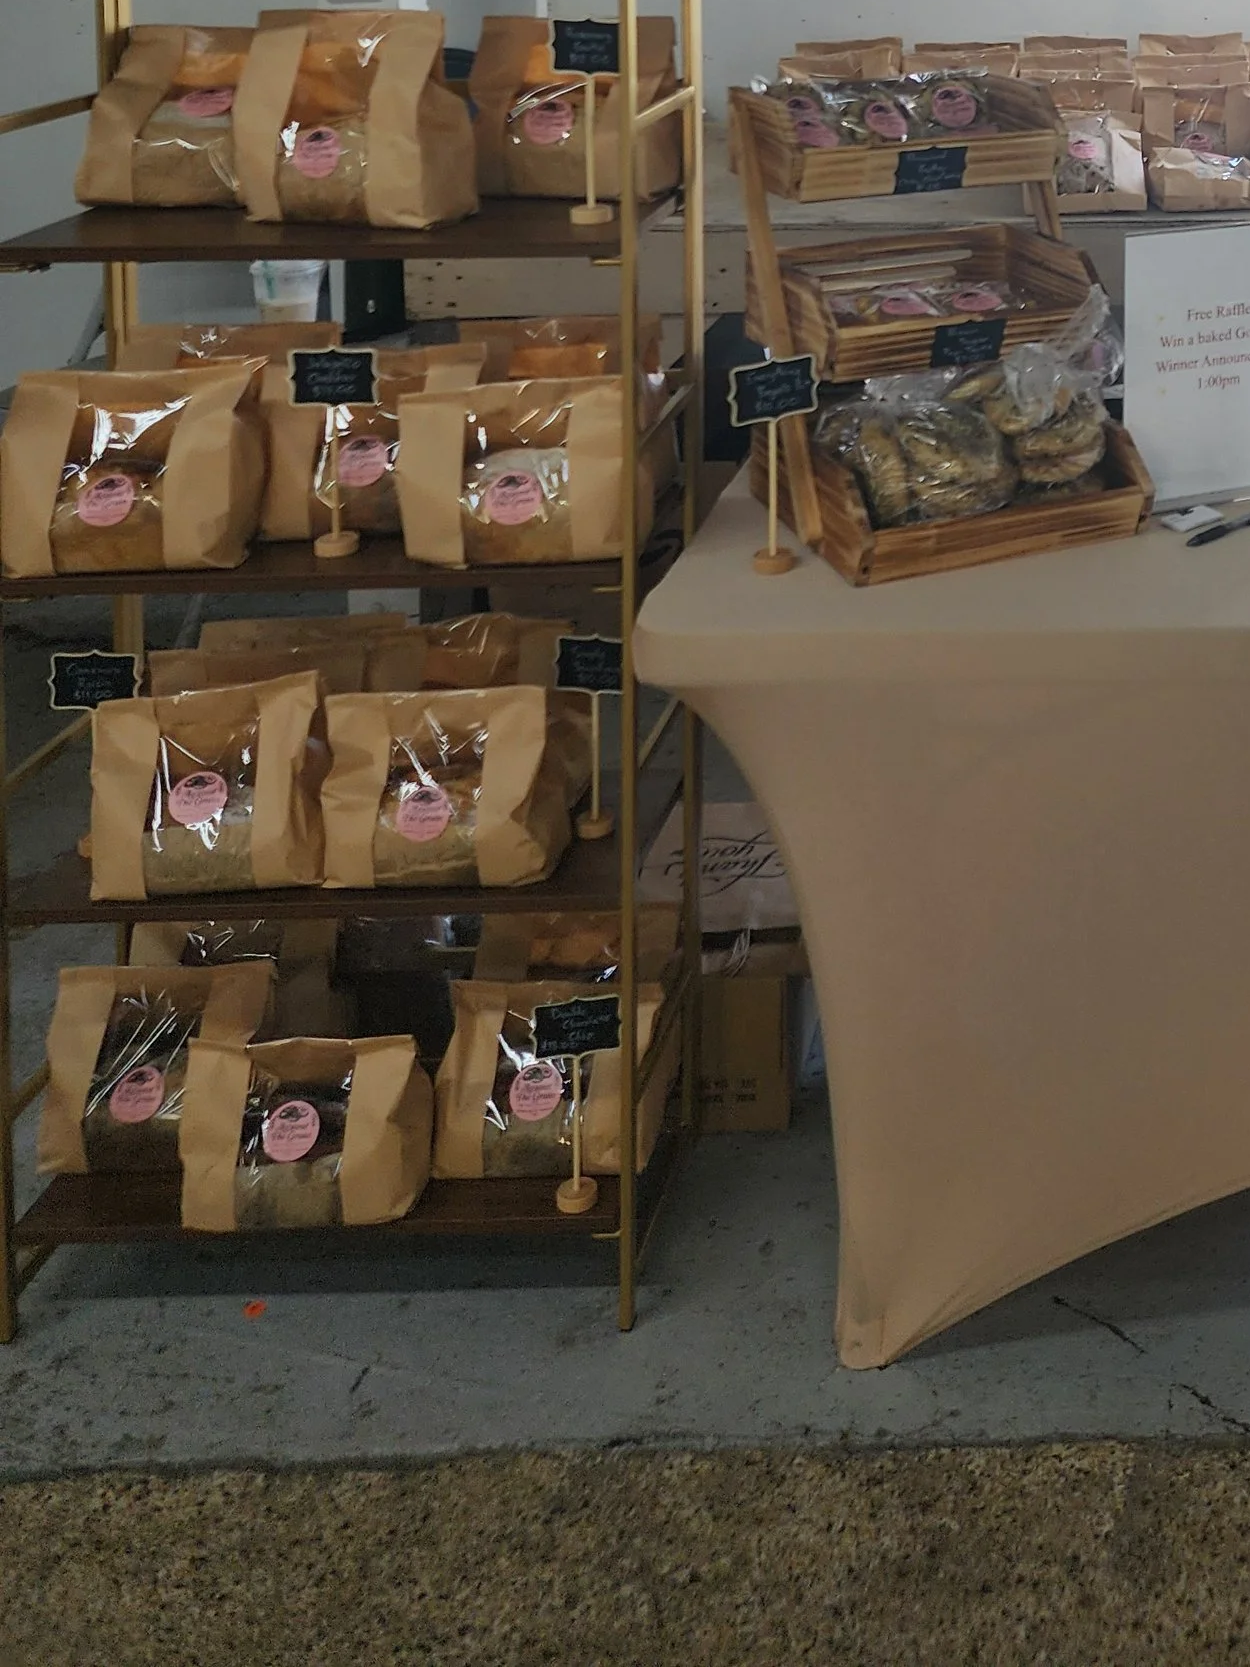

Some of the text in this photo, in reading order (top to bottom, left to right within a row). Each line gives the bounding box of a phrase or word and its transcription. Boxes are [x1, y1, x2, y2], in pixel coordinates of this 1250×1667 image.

[1186, 308, 1213, 322] Free
[1160, 335, 1185, 348] Win
[1187, 336, 1195, 346] a
[1198, 328, 1233, 345] baked
[1155, 358, 1199, 375] Winner
[1197, 374, 1241, 391] 1:00pm
